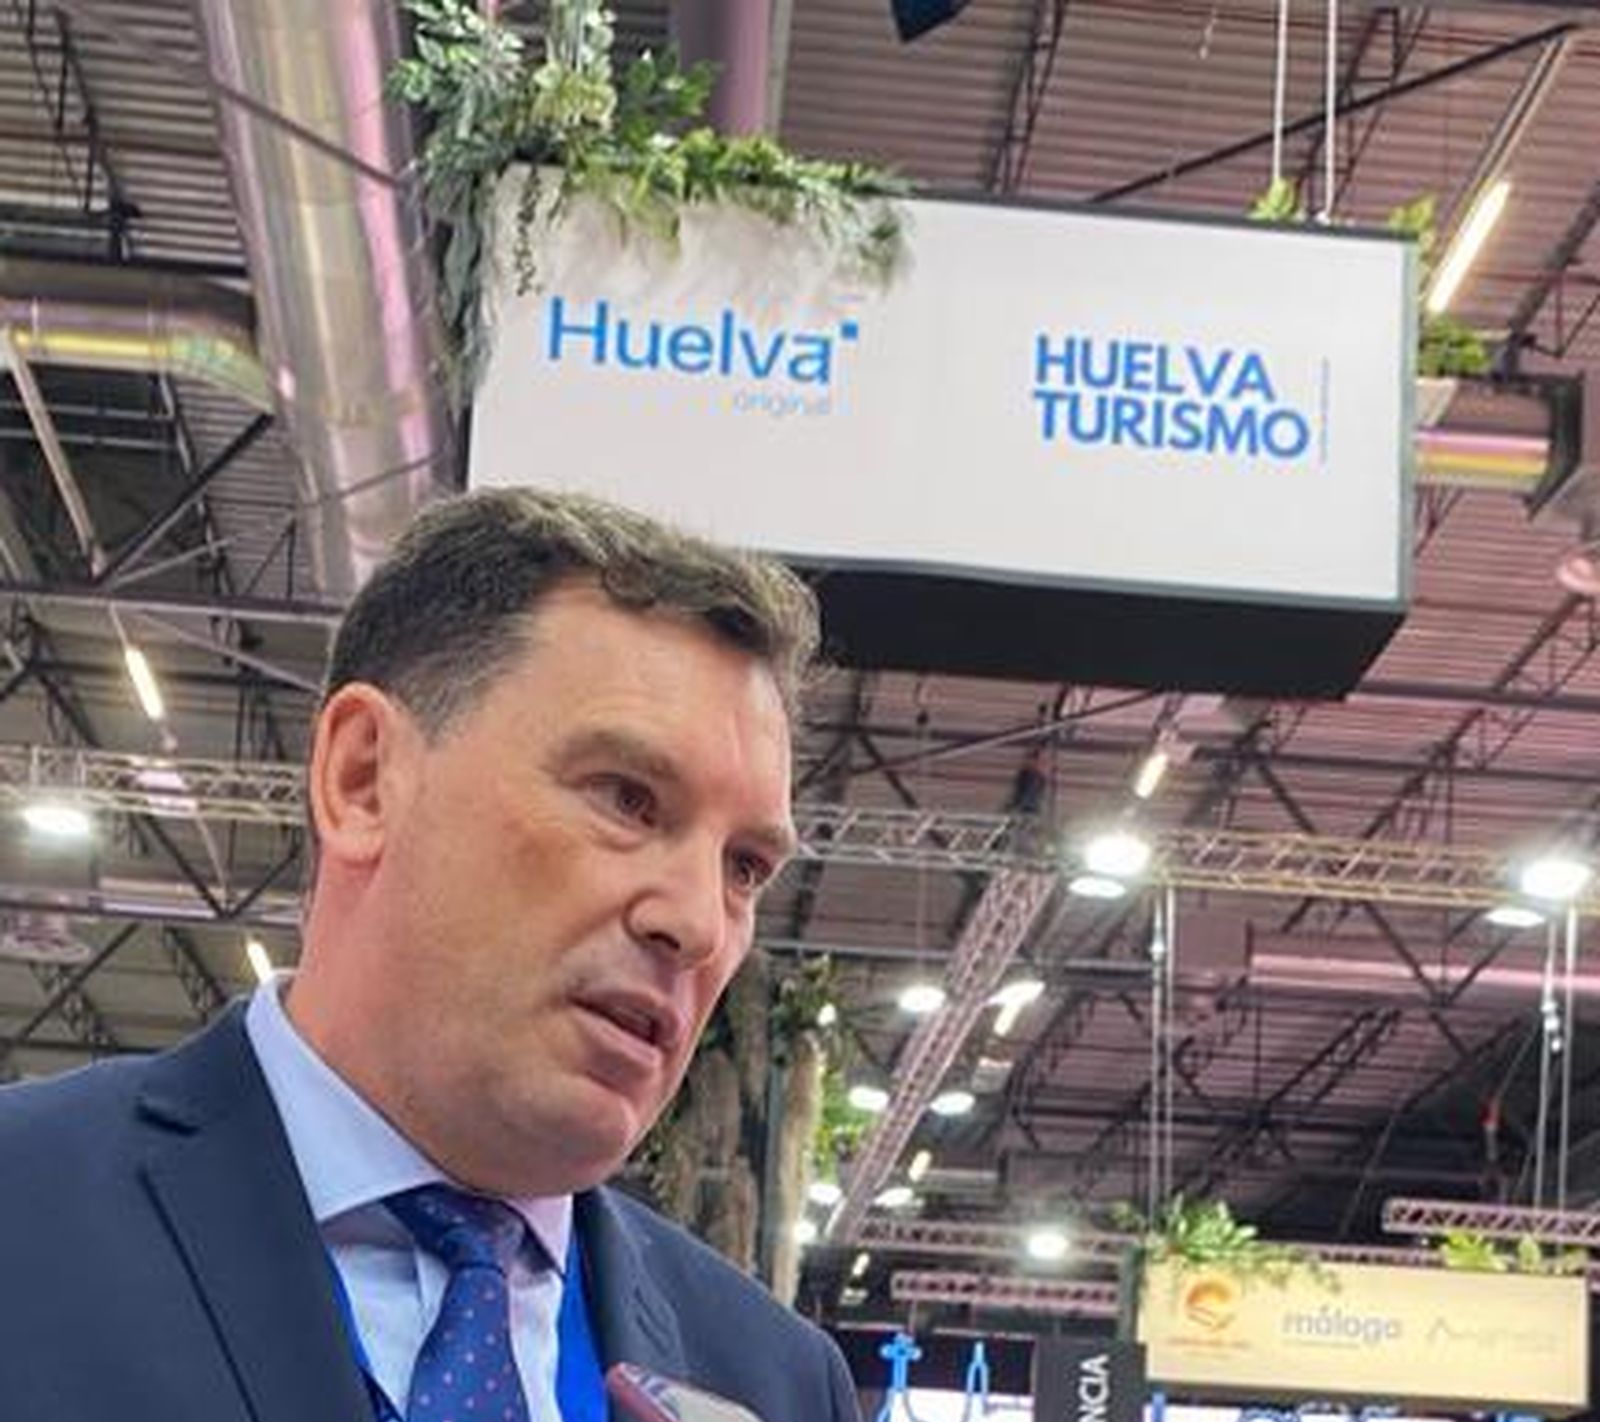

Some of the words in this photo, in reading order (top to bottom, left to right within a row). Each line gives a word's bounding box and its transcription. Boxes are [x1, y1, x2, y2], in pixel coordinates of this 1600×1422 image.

[548, 296, 831, 385] Huelva
[1036, 334, 1276, 402] HUELVA
[1032, 389, 1310, 458] TURISMO
